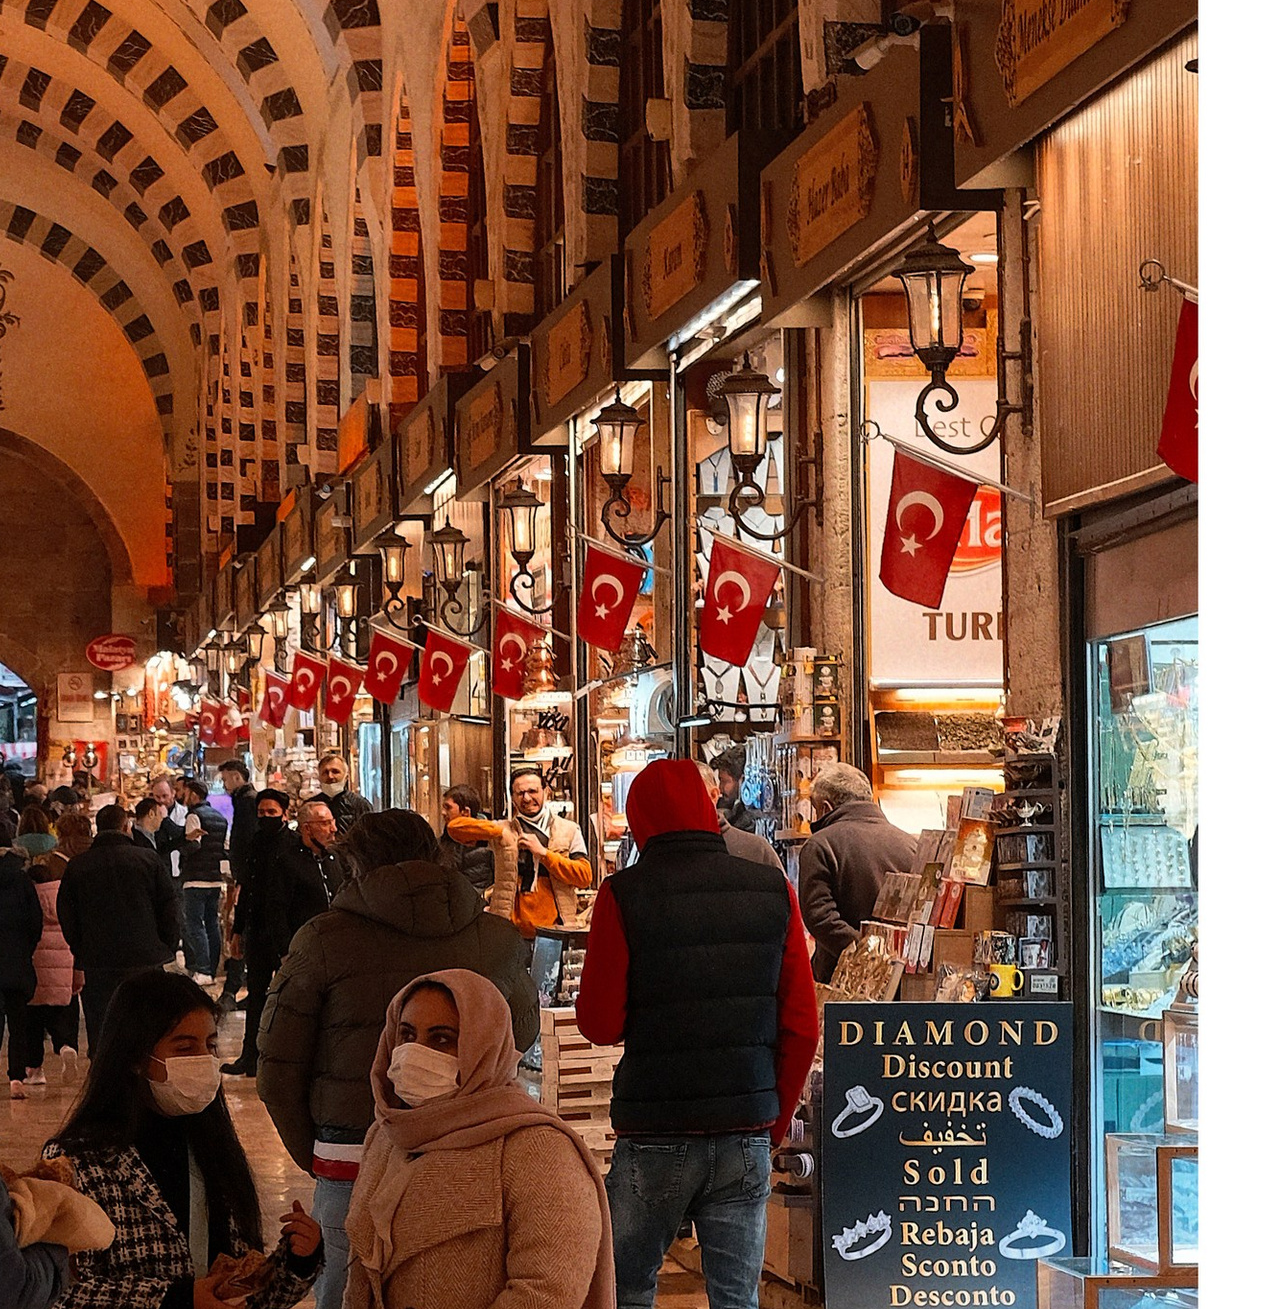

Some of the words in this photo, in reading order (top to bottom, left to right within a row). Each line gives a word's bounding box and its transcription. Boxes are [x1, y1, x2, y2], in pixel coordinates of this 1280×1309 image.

[923, 613, 1002, 640] TUR
[838, 1020, 1059, 1046] DIAMOND
[882, 1054, 1013, 1079] Discount
[891, 1090, 1003, 1118] скидка
[898, 1120, 987, 1155] تخفيف
[903, 1157, 990, 1185] Sold
[900, 1222, 995, 1252] Rebaja
[901, 1254, 997, 1277] Sconto
[889, 1285, 1017, 1307] Desconto
